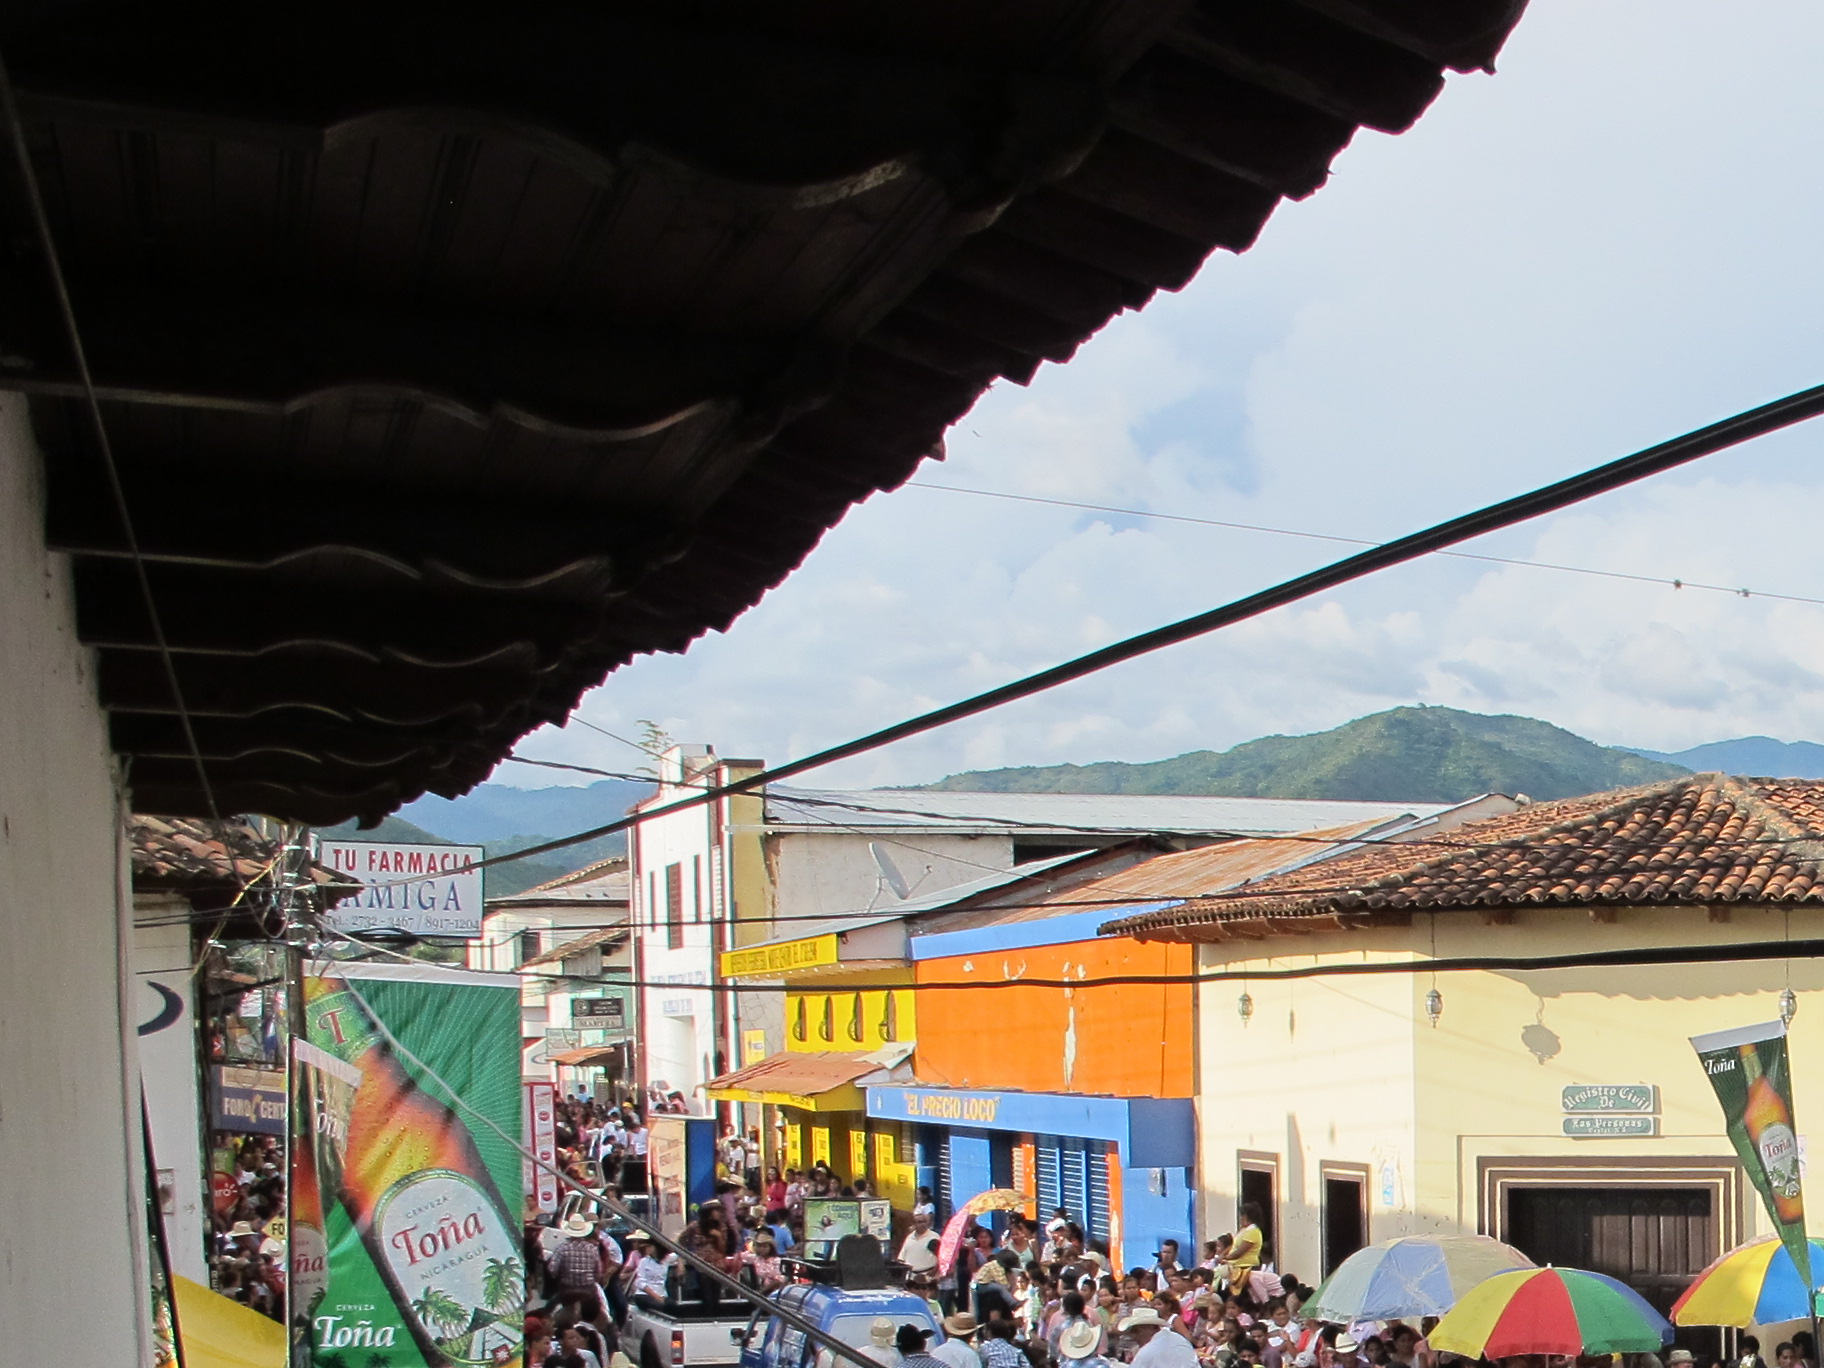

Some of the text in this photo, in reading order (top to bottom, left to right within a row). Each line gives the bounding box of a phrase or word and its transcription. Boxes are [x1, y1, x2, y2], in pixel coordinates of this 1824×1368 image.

[333, 849, 475, 876] TU FARMACIA
[1704, 1058, 1736, 1076] Toña
[921, 1095, 961, 1119] PRECIO
[1564, 1086, 1651, 1111] Registro Civil
[1598, 1095, 1616, 1110] De
[1571, 1117, 1644, 1129] Las Personas
[1763, 1137, 1793, 1159] Toña
[406, 1195, 450, 1220] CERVEZA
[391, 1211, 487, 1267] Toña
[419, 1244, 490, 1281] NICARAGUA
[335, 1303, 376, 1312] CERVEZA
[314, 1315, 397, 1349] Toña
